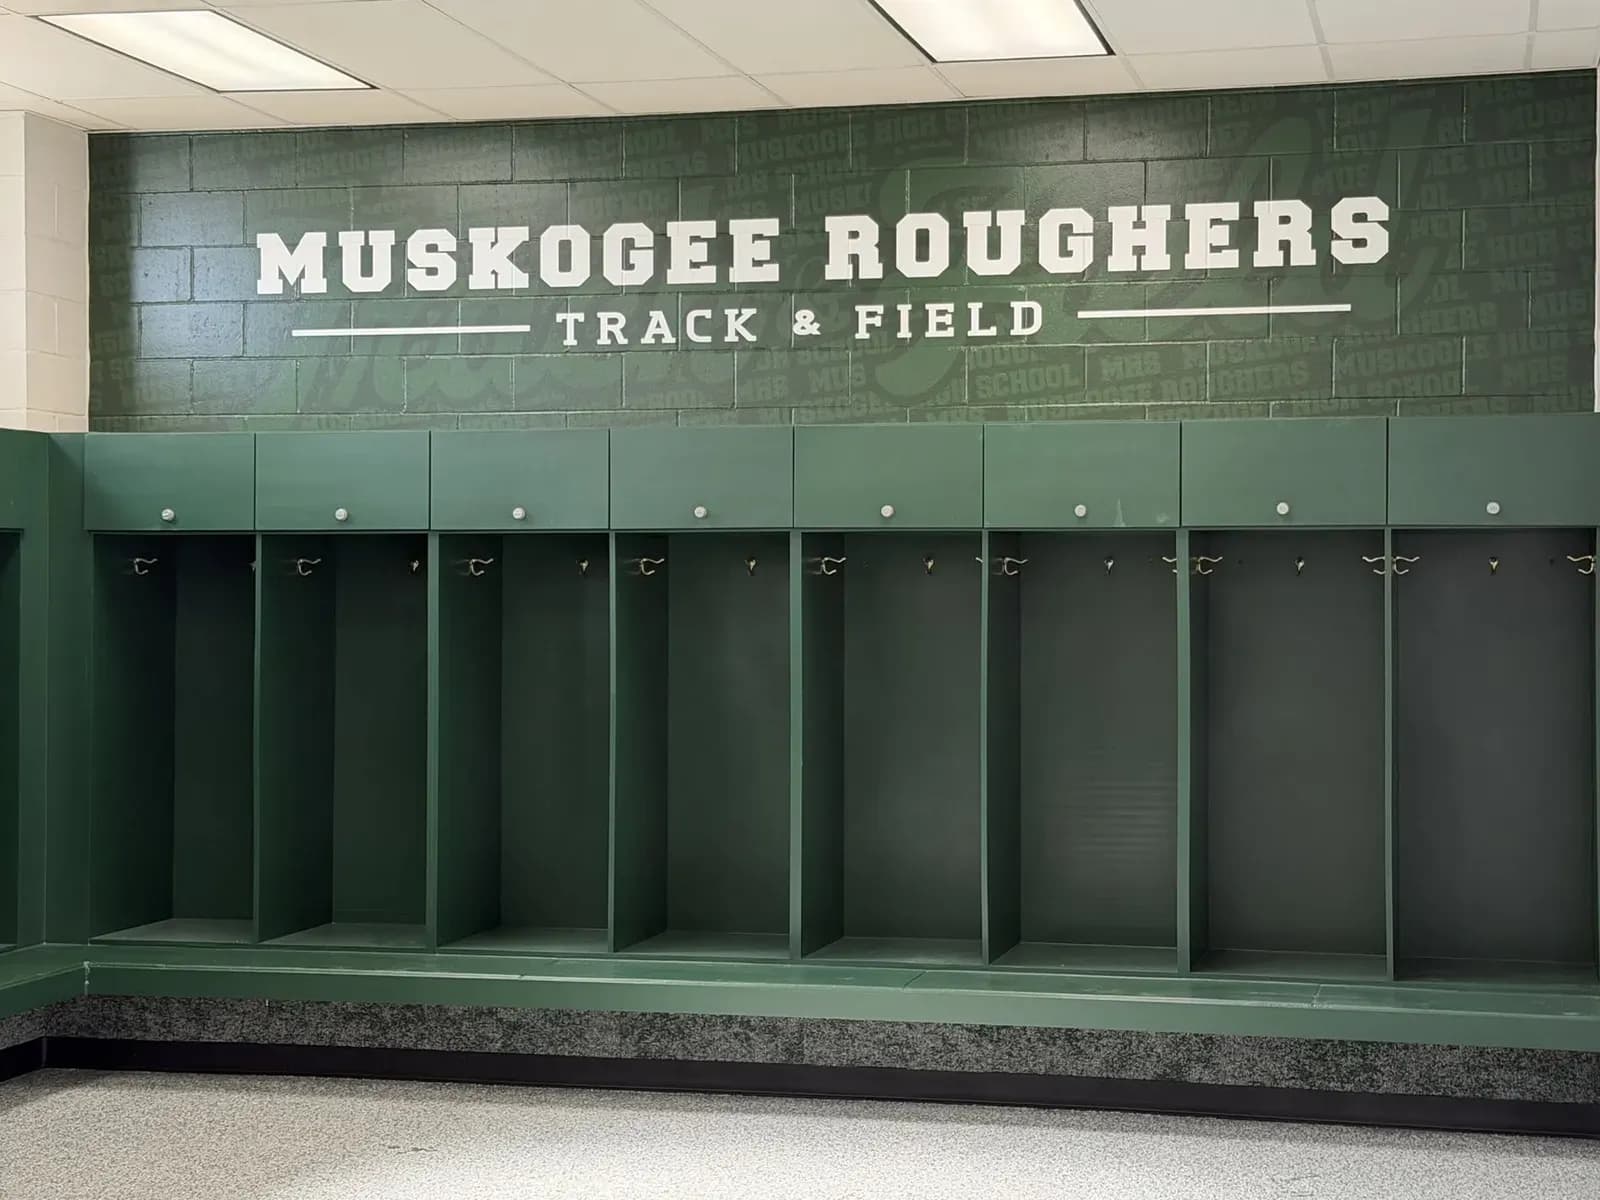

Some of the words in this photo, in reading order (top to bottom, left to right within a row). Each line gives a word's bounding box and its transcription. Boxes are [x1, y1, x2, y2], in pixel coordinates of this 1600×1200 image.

[256, 217, 780, 297] MUSKOGEE
[825, 195, 1391, 281] ROUGHERS
[555, 307, 758, 347] TRACK
[792, 309, 822, 337] &
[854, 301, 1043, 340] FIELD
